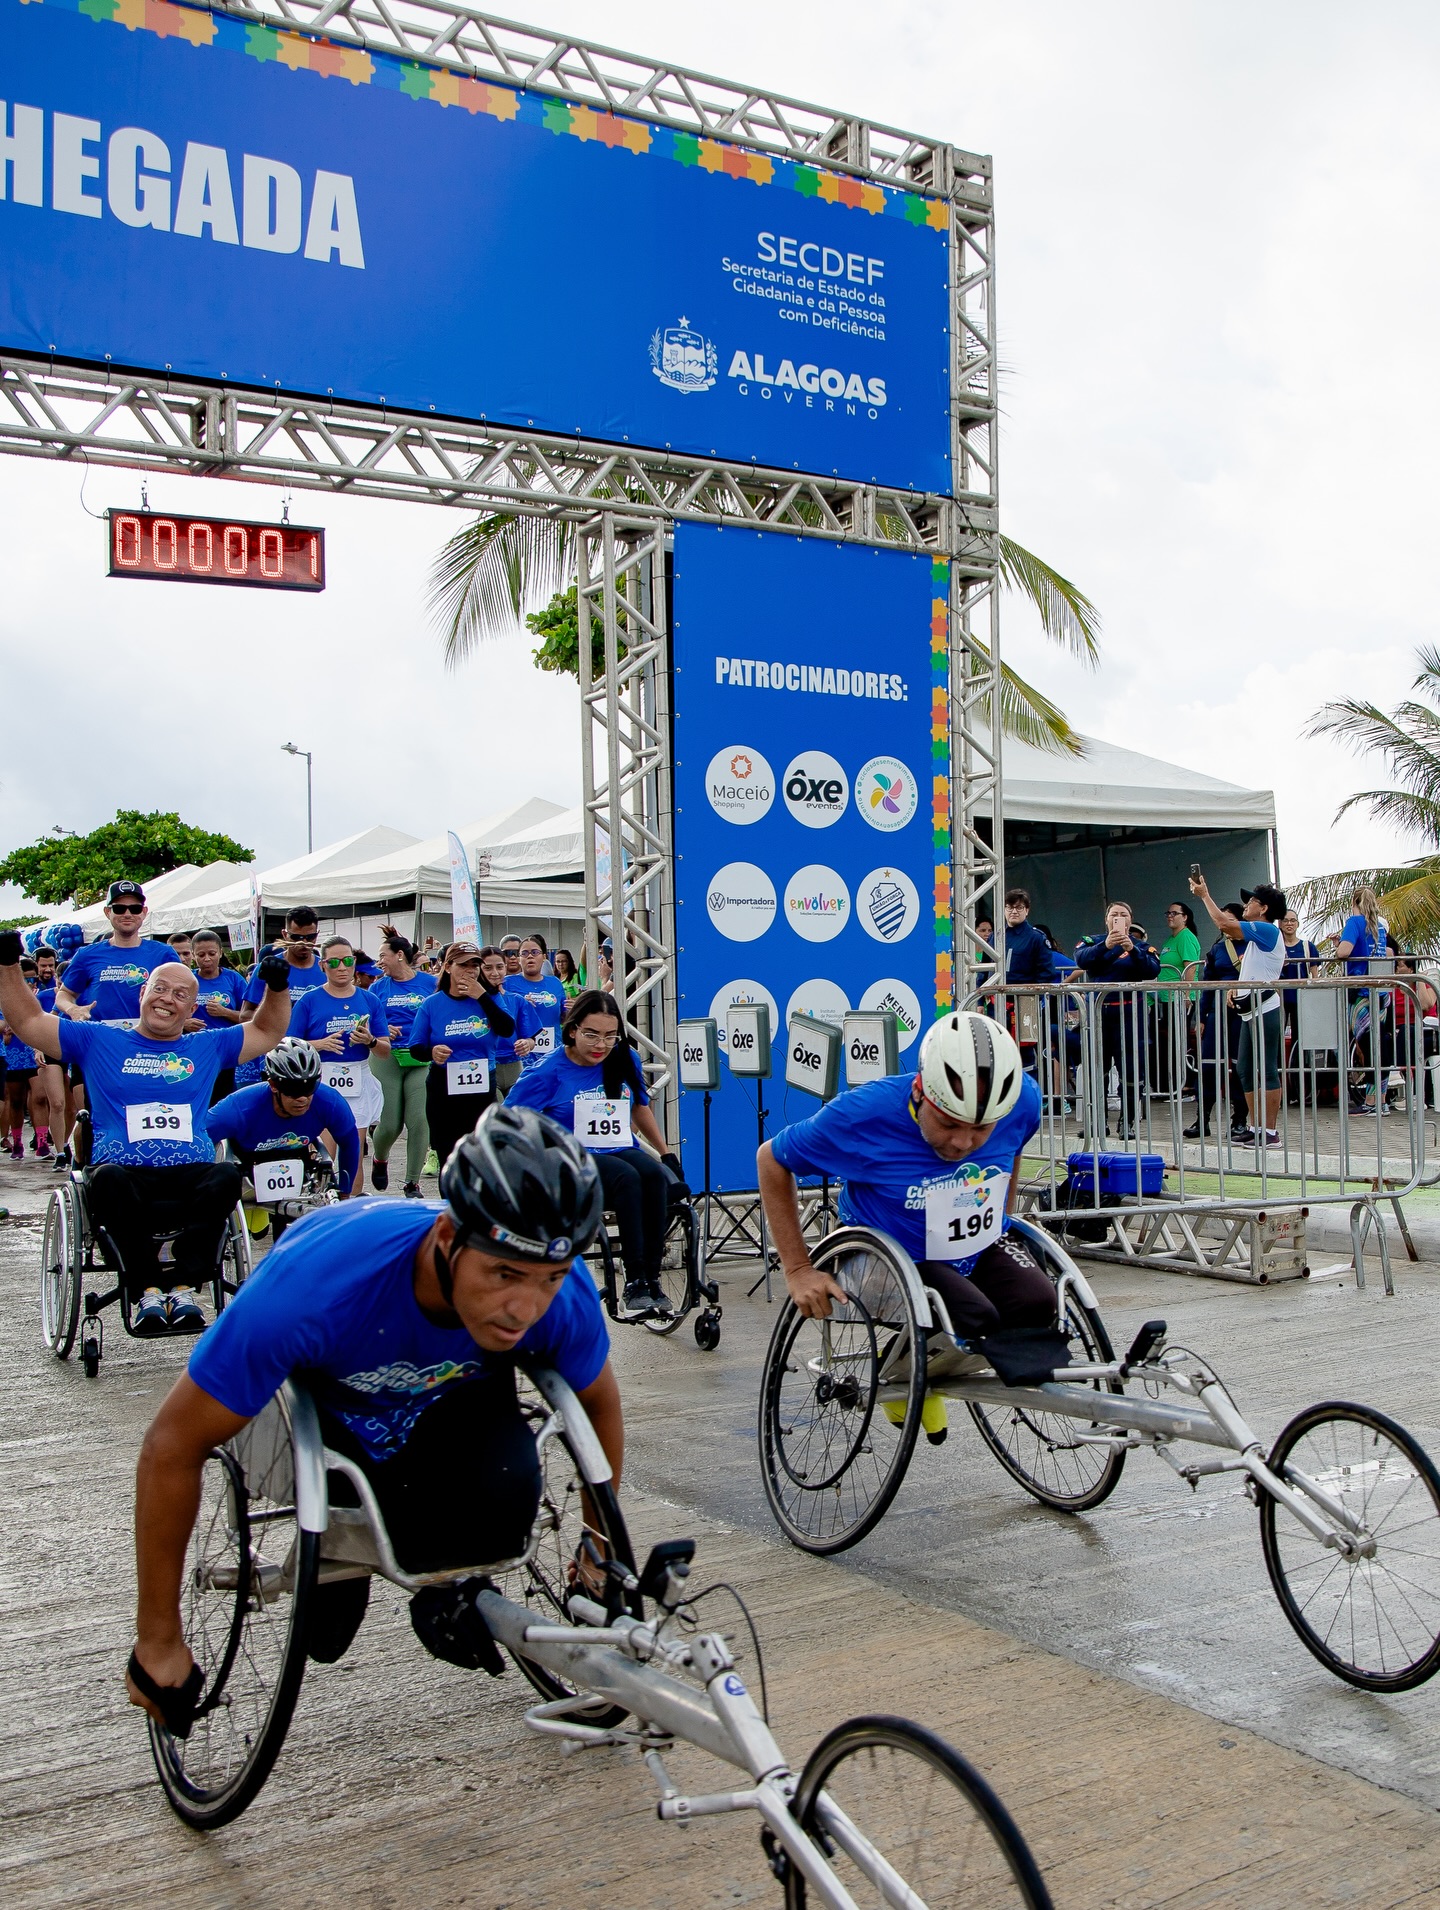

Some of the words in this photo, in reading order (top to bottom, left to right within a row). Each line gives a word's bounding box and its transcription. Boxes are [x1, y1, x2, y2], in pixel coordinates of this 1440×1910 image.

[0, 100, 365, 269] HEGADA
[757, 231, 885, 286] SECDEF
[721, 257, 794, 286] Secretaria
[797, 276, 814, 290] de
[818, 279, 866, 302] Estado
[868, 292, 886, 307] da
[733, 277, 804, 305] Cidadania
[806, 297, 815, 307] e
[818, 298, 836, 312] da
[839, 302, 886, 324] Pessoa
[779, 308, 809, 323] com
[812, 312, 886, 341] Deficiência
[727, 350, 888, 406] ALAGOAS
[738, 383, 878, 420] GOVERNO
[715, 656, 909, 702] PATROCINADORES:
[713, 785, 770, 801] Maceió
[786, 769, 844, 804] ôxe
[713, 800, 746, 810] Shopping
[806, 802, 843, 811] eventos
[726, 896, 776, 906] Importadora
[885, 992, 917, 1031] MERLIN
[732, 1028, 754, 1049] ôxe
[850, 1038, 879, 1061] ôxe
[123, 1058, 167, 1068] CORRIDA
[683, 1043, 703, 1063] ôxe
[793, 1042, 821, 1070] ôxe
[121, 1066, 161, 1076] CORAÇÃO
[457, 1073, 483, 1086] 112
[329, 1077, 354, 1088] 006
[142, 1116, 181, 1130] 199
[587, 1119, 621, 1136] 195
[267, 1175, 295, 1191] 001
[948, 1206, 994, 1243] 196
